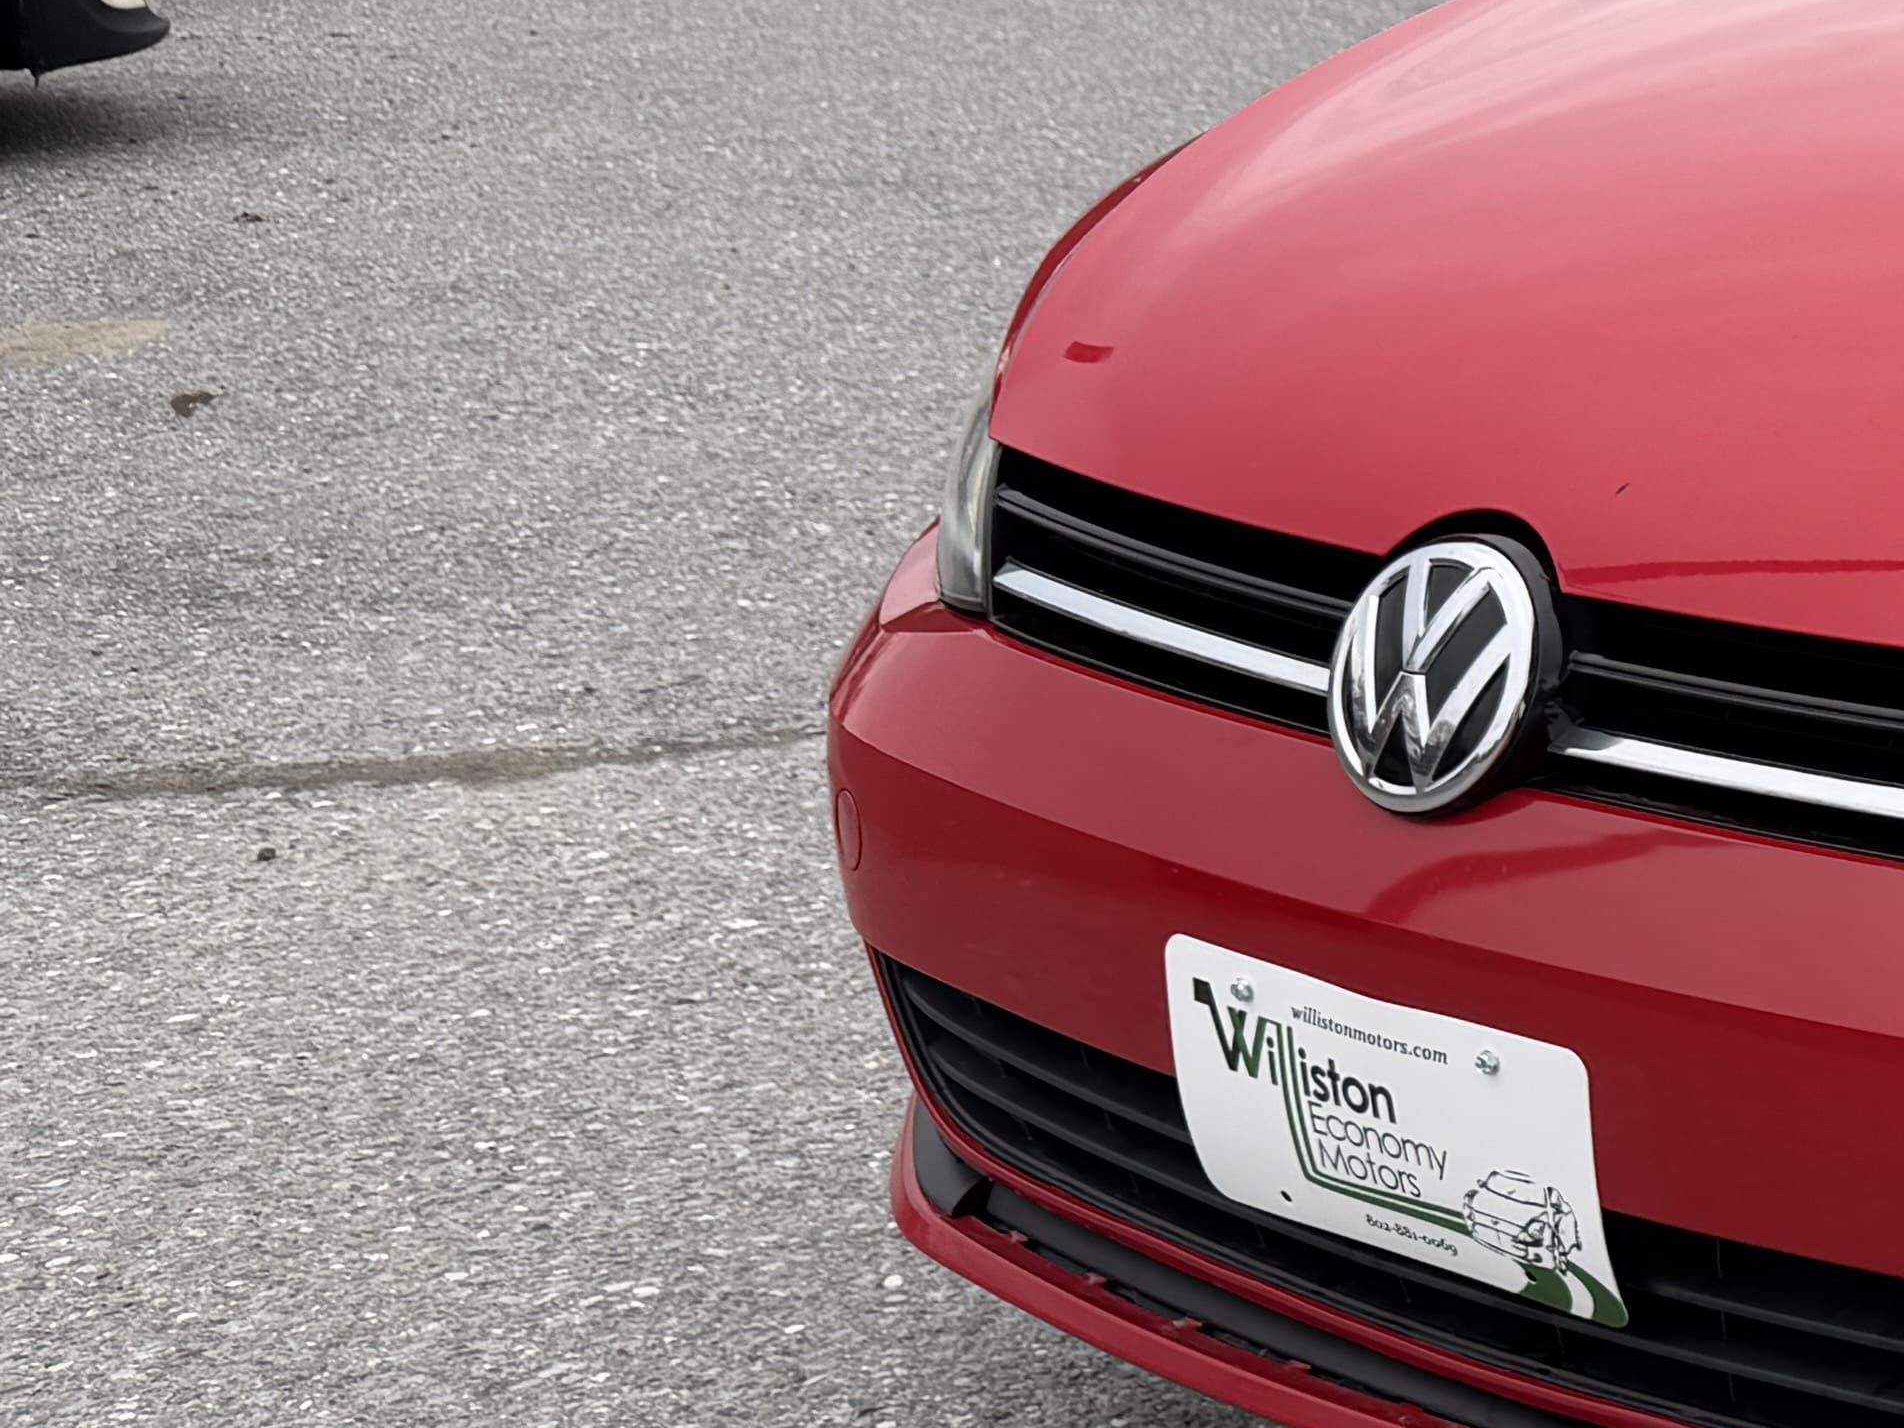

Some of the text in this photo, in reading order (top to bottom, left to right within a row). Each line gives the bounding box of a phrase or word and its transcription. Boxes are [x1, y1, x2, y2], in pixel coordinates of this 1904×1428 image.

[1192, 976, 1397, 1125] Williston
[1290, 1006, 1448, 1065] willistonmotors.com
[1308, 1100, 1447, 1180] Economy
[1318, 1139, 1422, 1198] Motors
